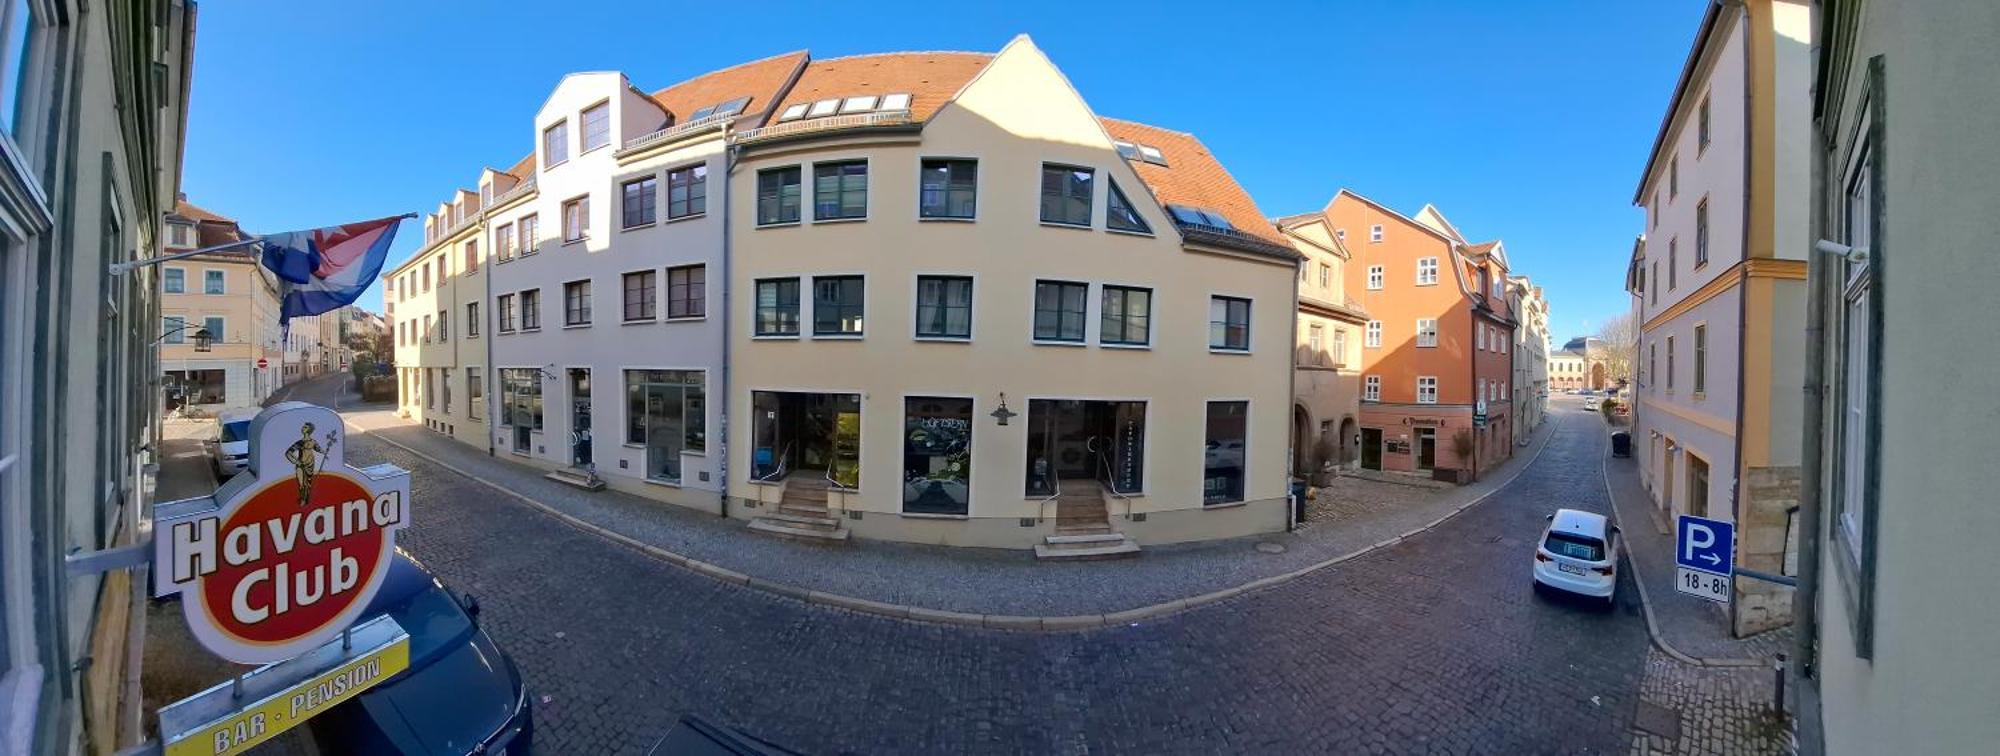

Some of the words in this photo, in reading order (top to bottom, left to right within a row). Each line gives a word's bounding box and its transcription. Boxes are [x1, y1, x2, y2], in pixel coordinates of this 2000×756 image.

[172, 490, 400, 583] Havana
[1686, 522, 1715, 560] P
[231, 547, 359, 625] Club
[1685, 573, 1699, 589] 18
[1712, 579, 1727, 596] 8h
[213, 711, 266, 755] BAR
[290, 657, 381, 719] PENSION
